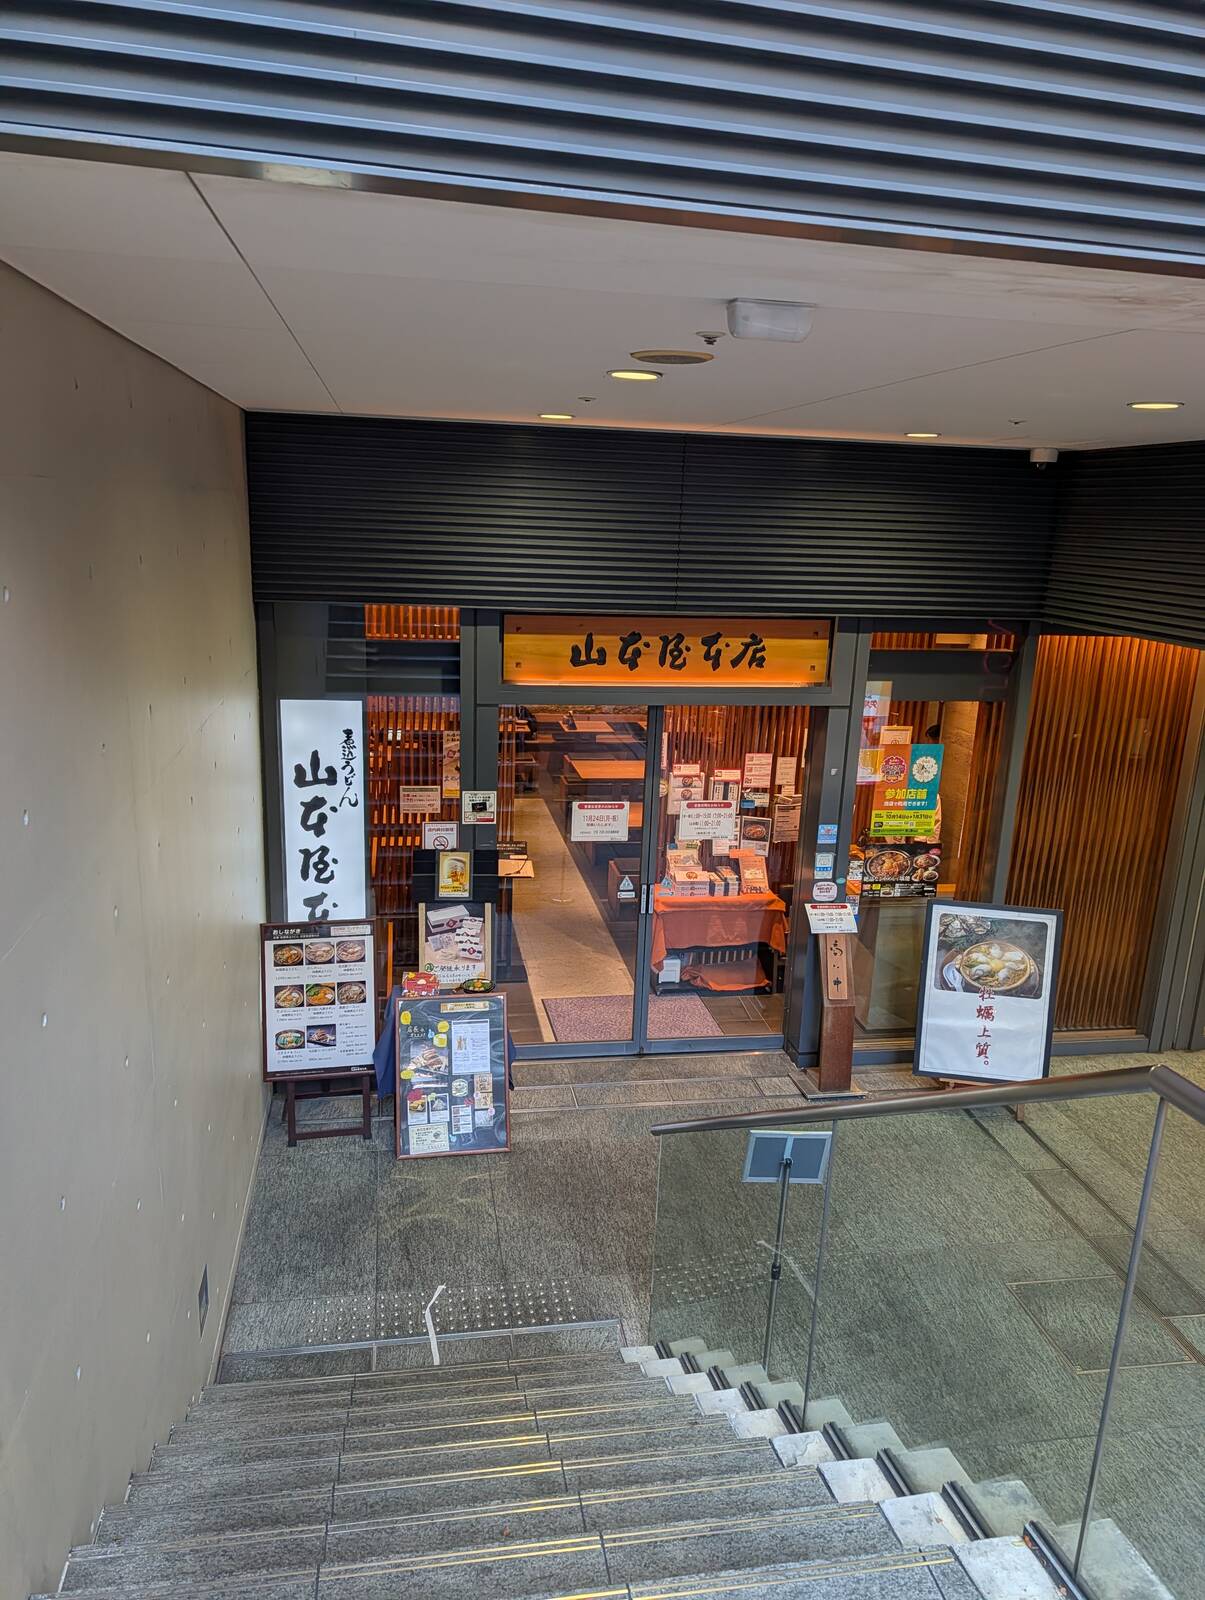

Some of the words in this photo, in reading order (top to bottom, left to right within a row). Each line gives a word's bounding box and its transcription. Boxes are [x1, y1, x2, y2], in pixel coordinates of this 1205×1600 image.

[570, 631, 767, 671] 山本屋本店
[885, 788, 928, 800] 参加店舗
[272, 928, 301, 936] おしながき
